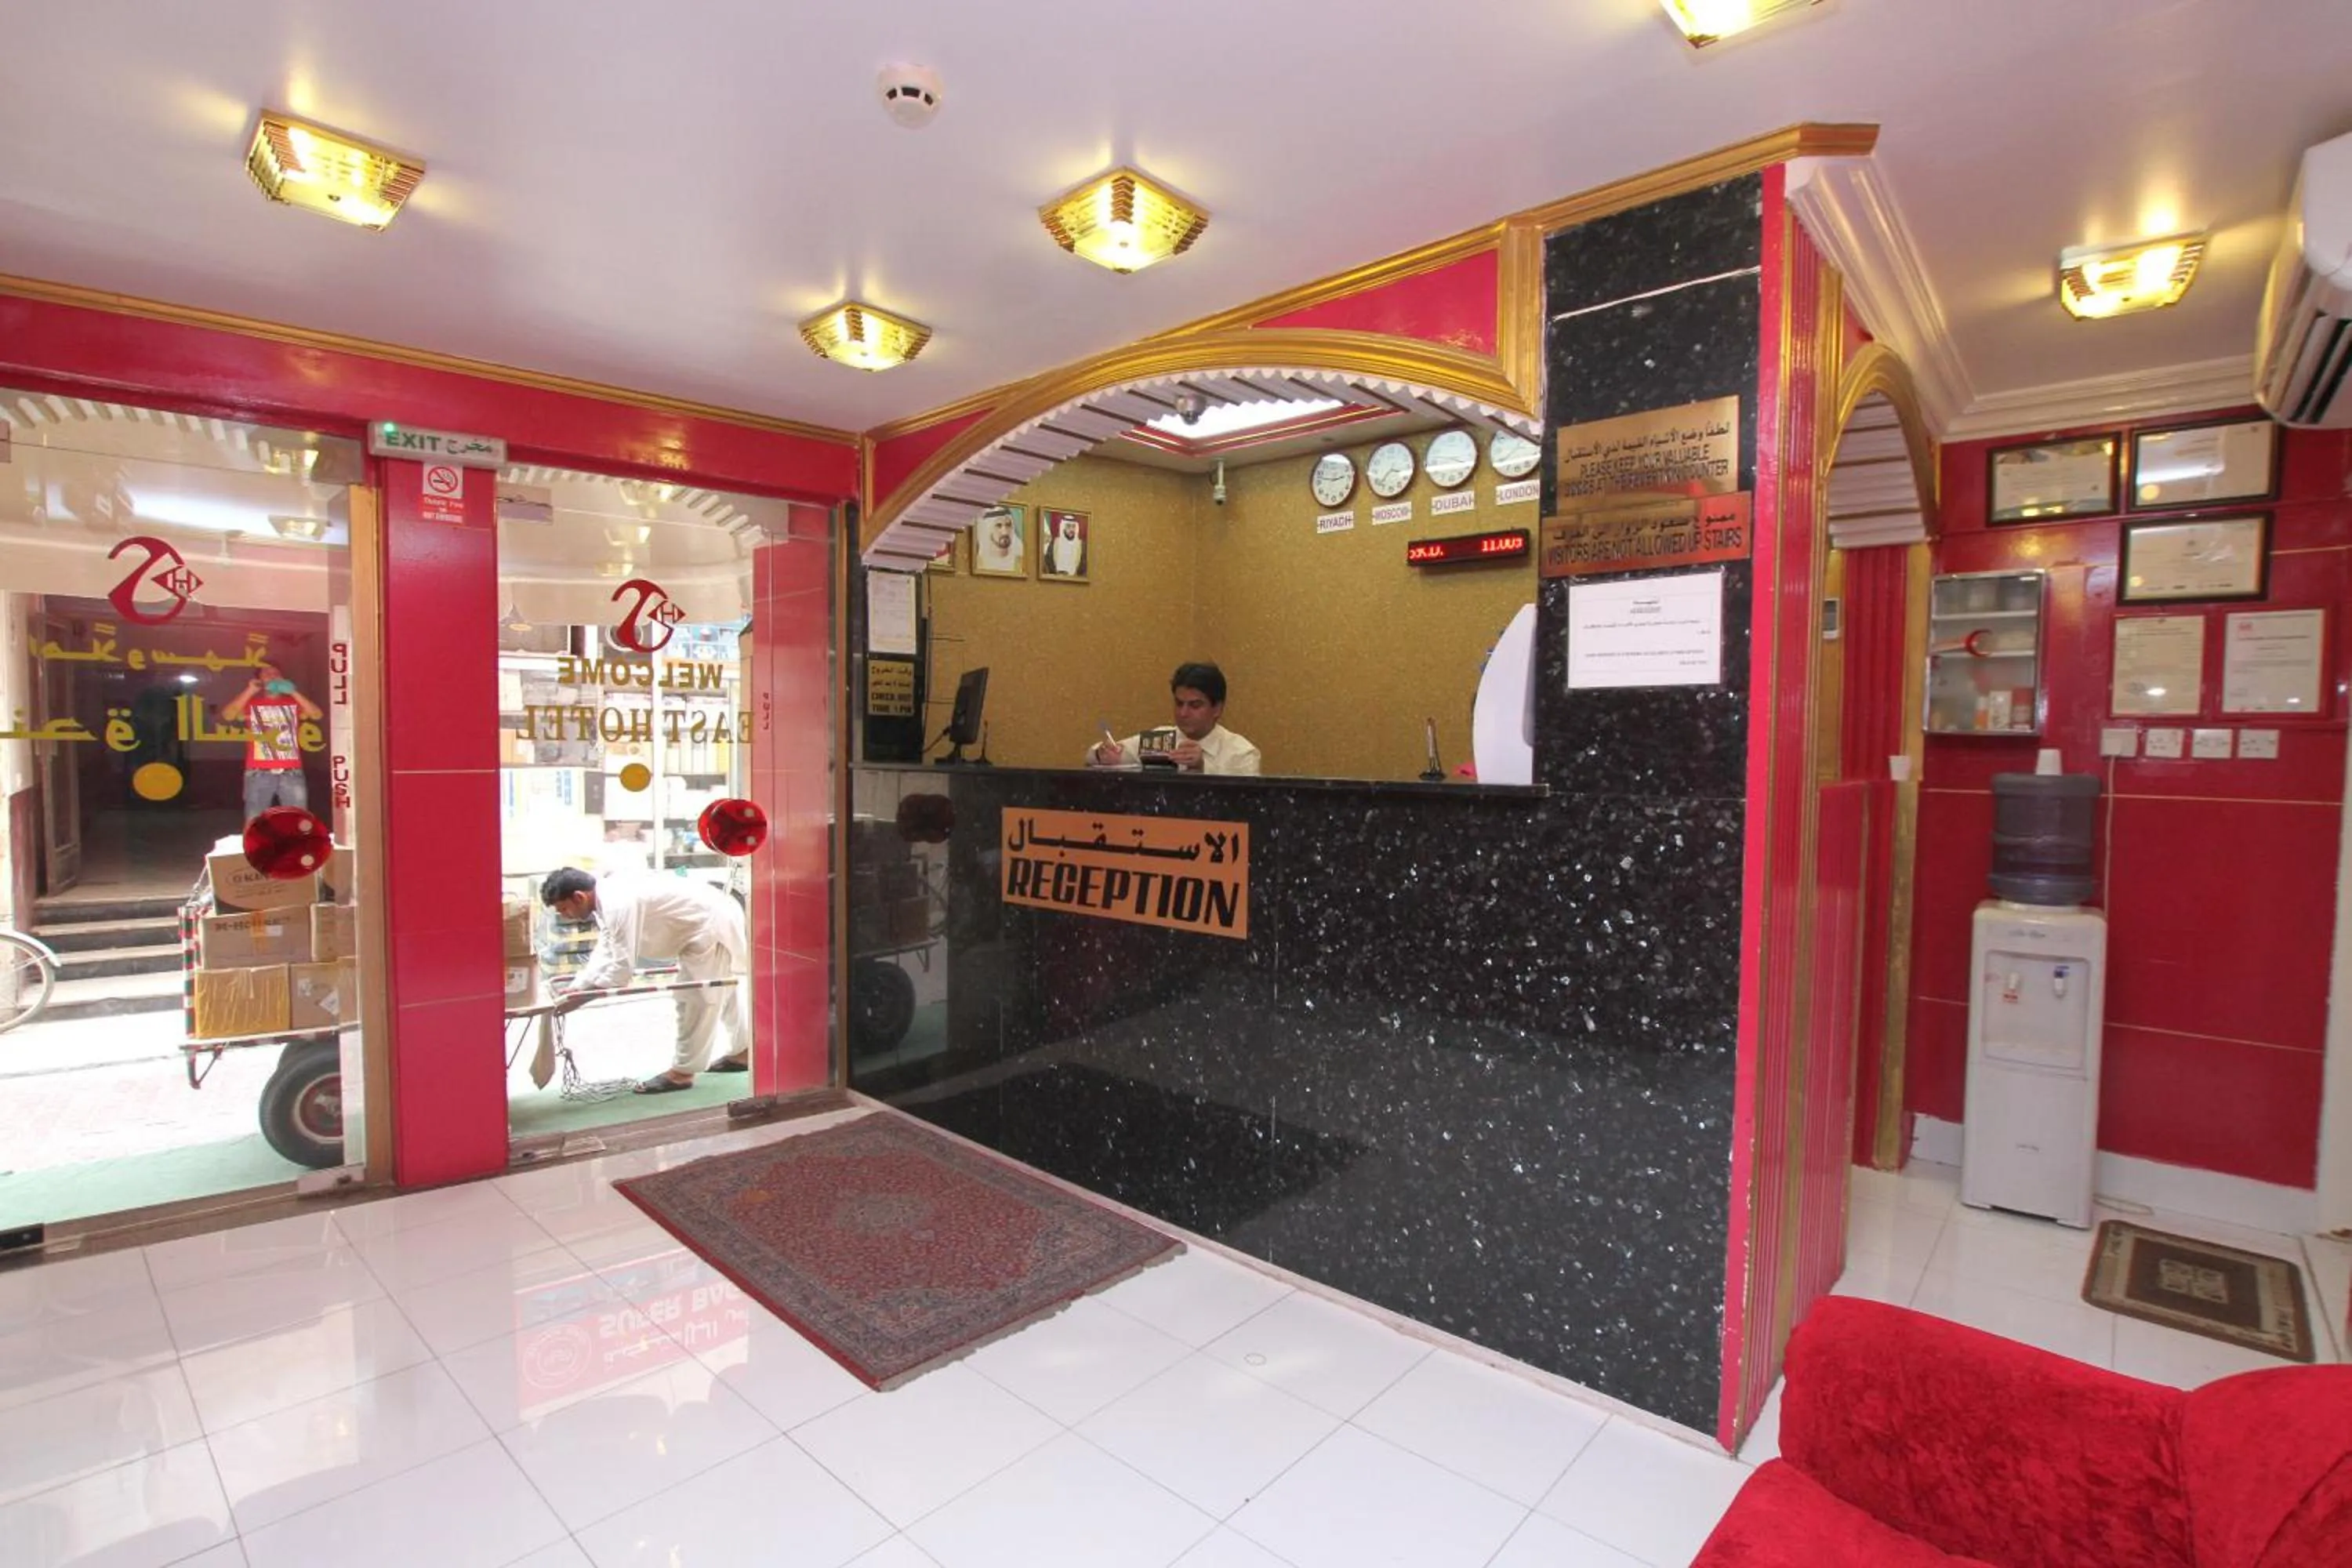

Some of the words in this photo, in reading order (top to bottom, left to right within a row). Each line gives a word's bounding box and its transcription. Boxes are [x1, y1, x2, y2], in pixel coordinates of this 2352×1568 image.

[386, 431, 441, 452] EXIT
[1704, 526, 1742, 550] STAIRS
[332, 756, 350, 808] PUSH
[1007, 818, 1240, 865] الاستقبال
[1007, 857, 1240, 928] RECEPTION
